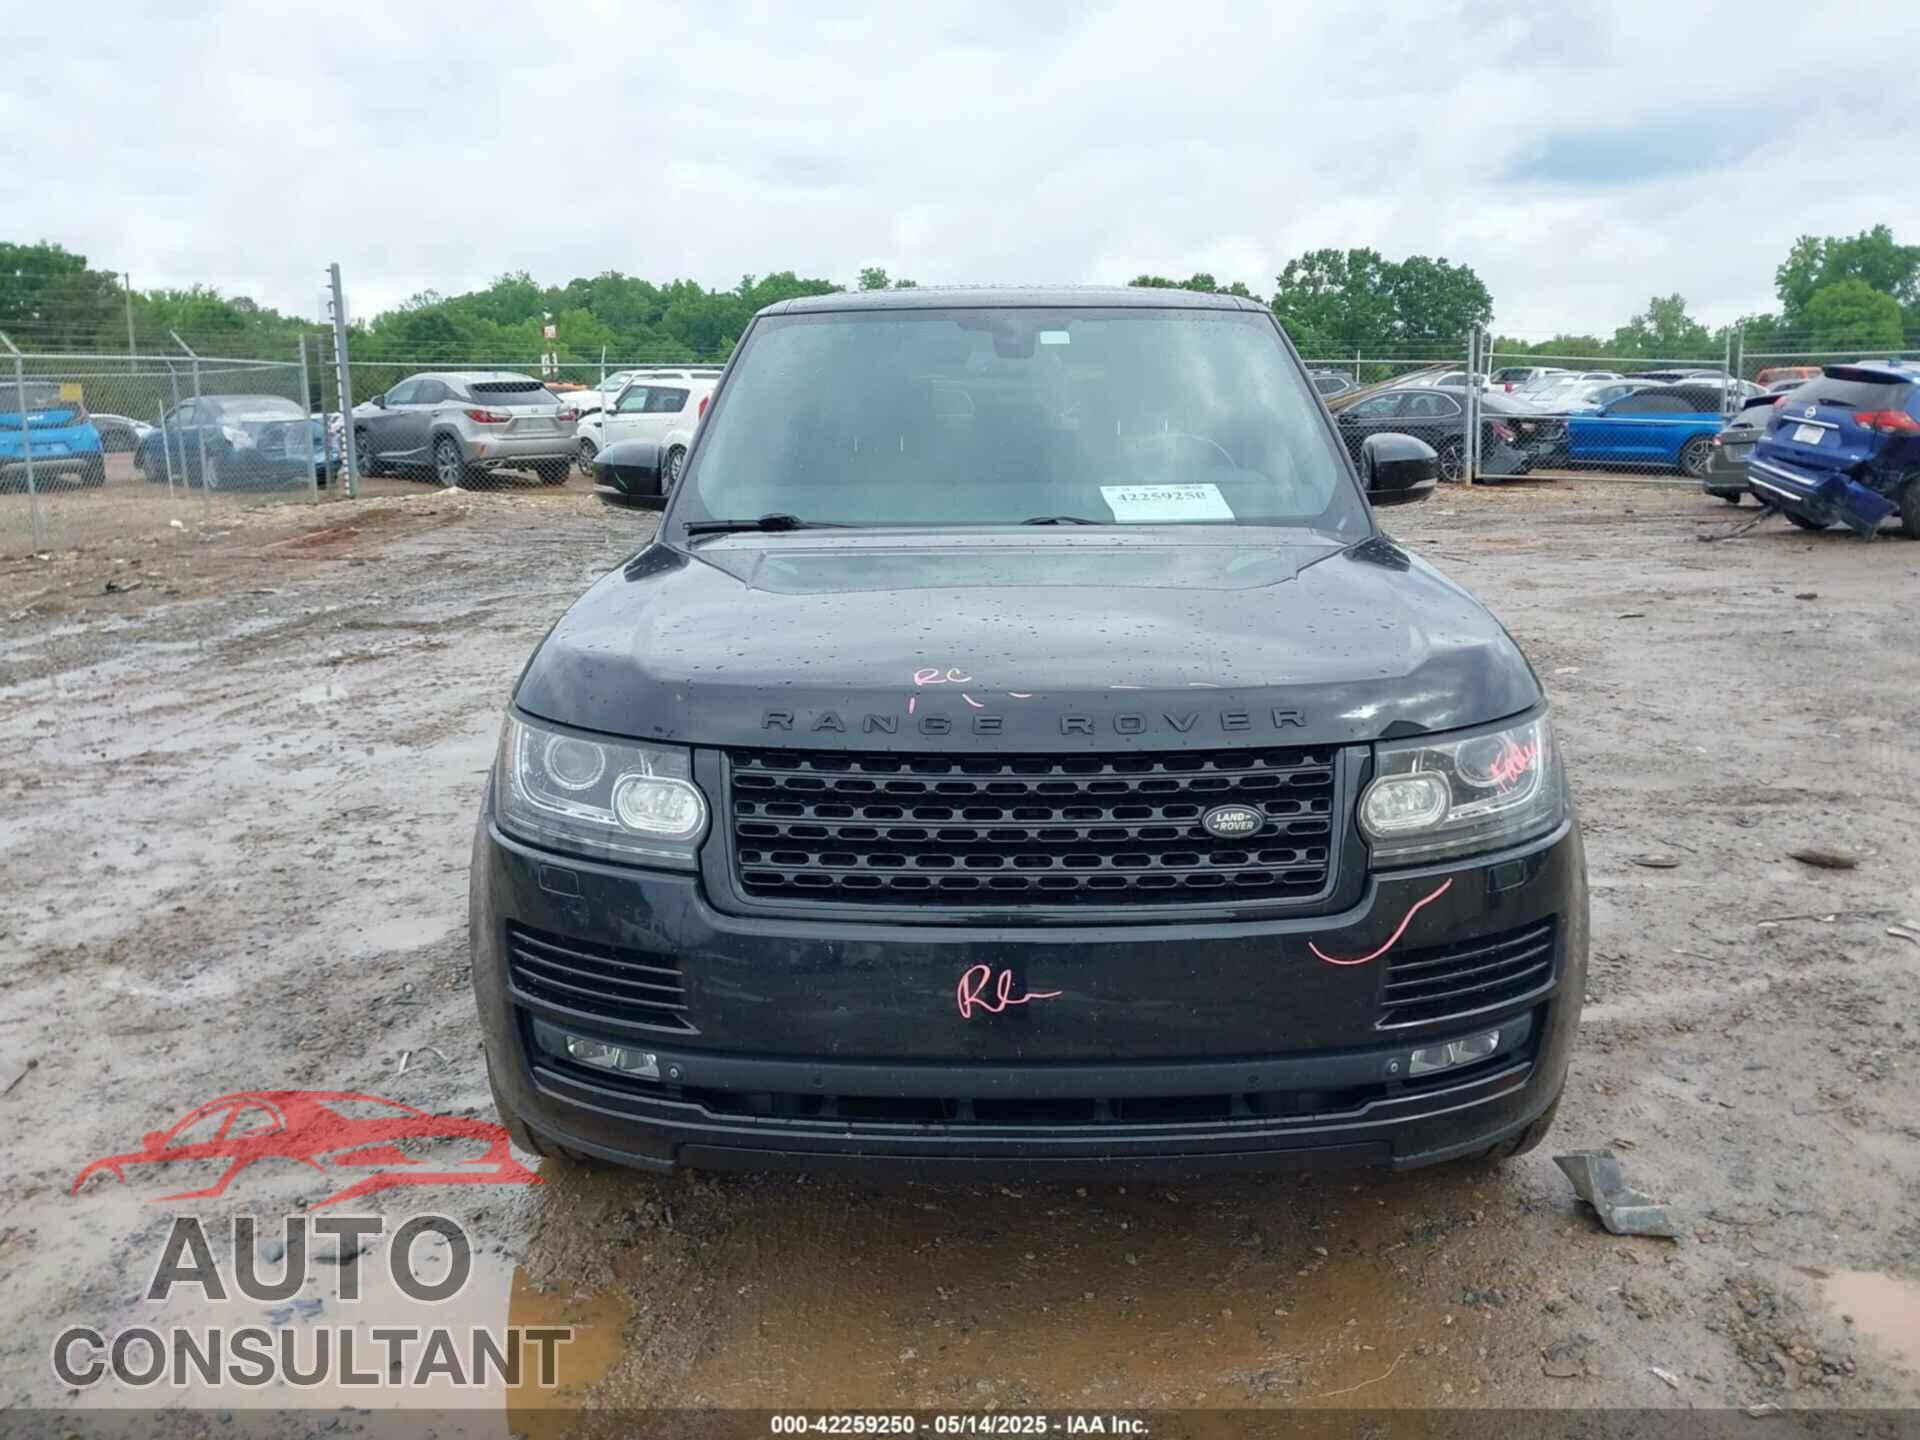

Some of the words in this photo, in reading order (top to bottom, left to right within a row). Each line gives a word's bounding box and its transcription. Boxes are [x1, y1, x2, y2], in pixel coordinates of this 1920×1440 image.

[761, 709, 1002, 736] RANGE
[1060, 708, 1308, 736] ROVER
[1216, 812, 1245, 822] LAND
[1219, 821, 1254, 831] ROVER
